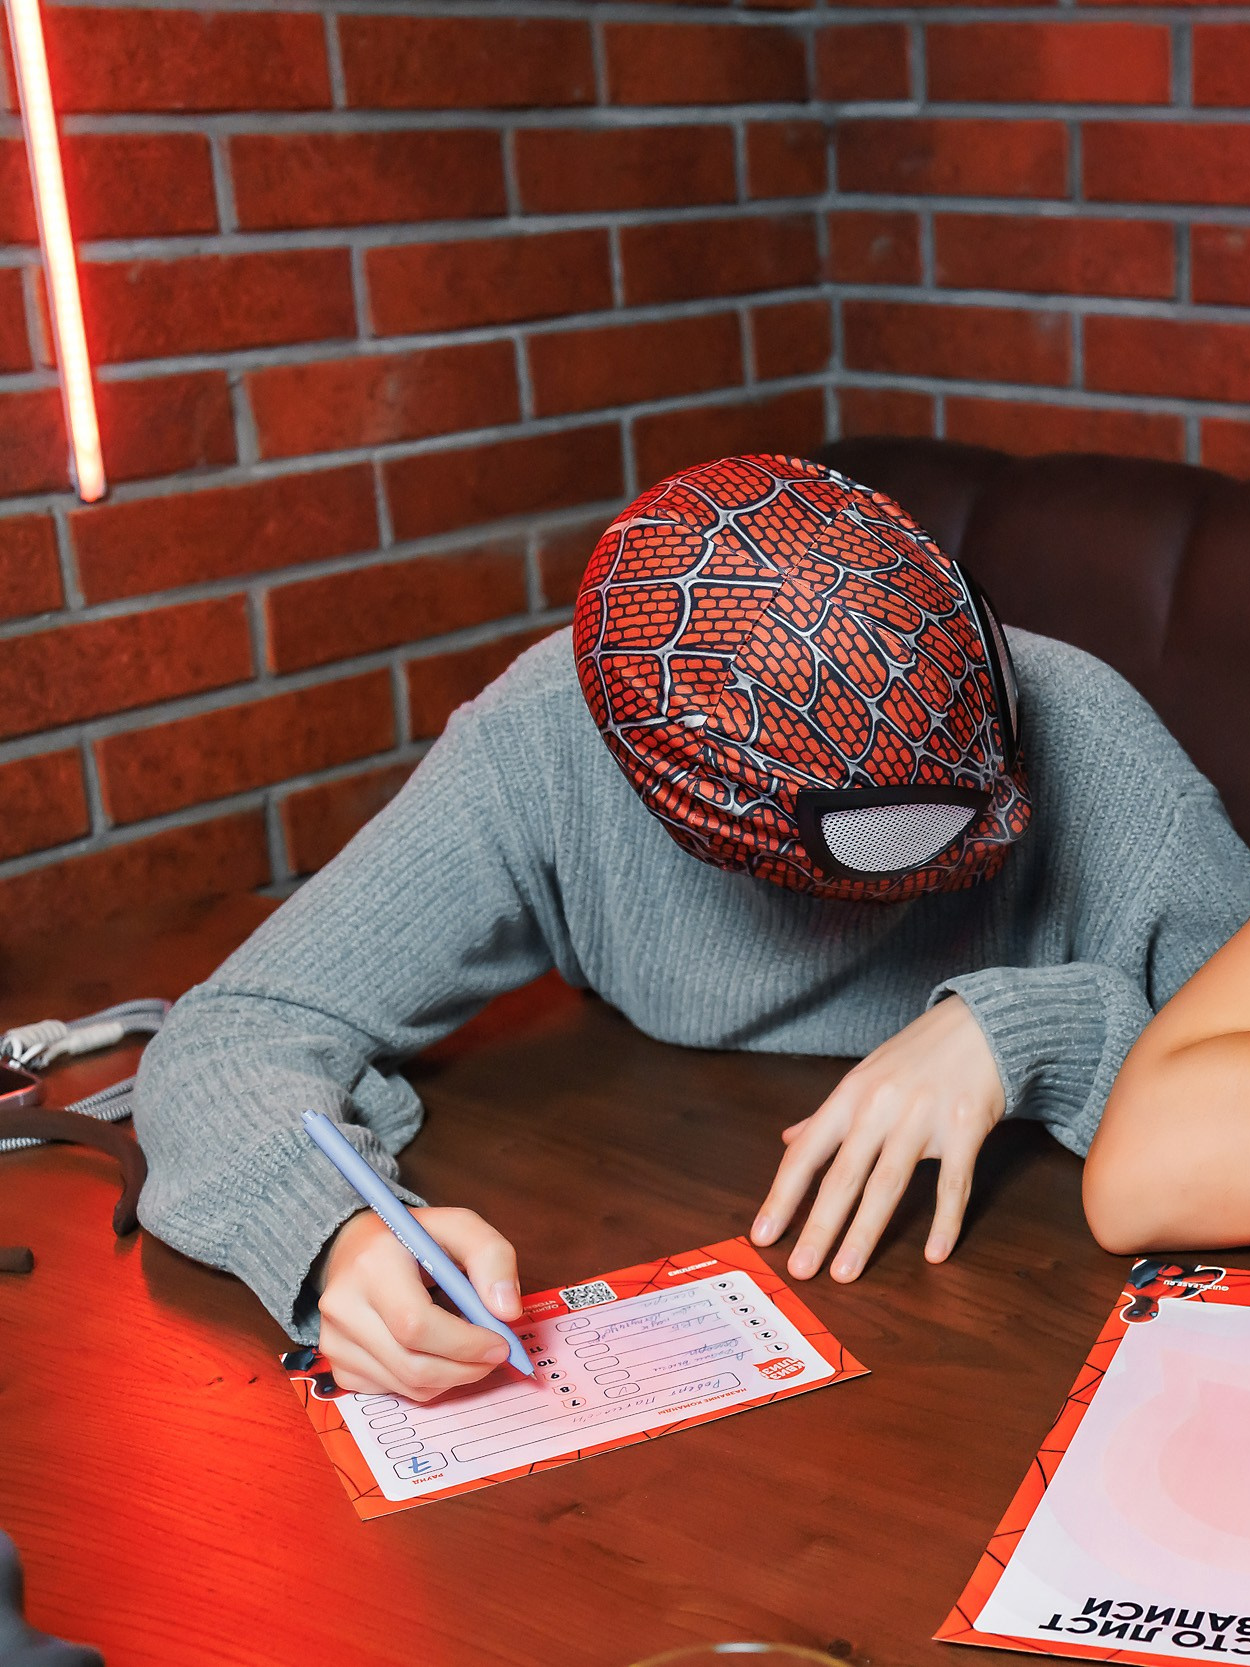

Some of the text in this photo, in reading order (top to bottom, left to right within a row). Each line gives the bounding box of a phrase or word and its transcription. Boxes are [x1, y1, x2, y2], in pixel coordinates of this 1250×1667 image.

[702, 1387, 746, 1403] НАЗВАНИЕ
[657, 1399, 701, 1415] КОМАНДЫ
[405, 1453, 432, 1475] 7
[411, 1472, 443, 1485] РАУНД
[1038, 1611, 1161, 1644] ЛИСТ
